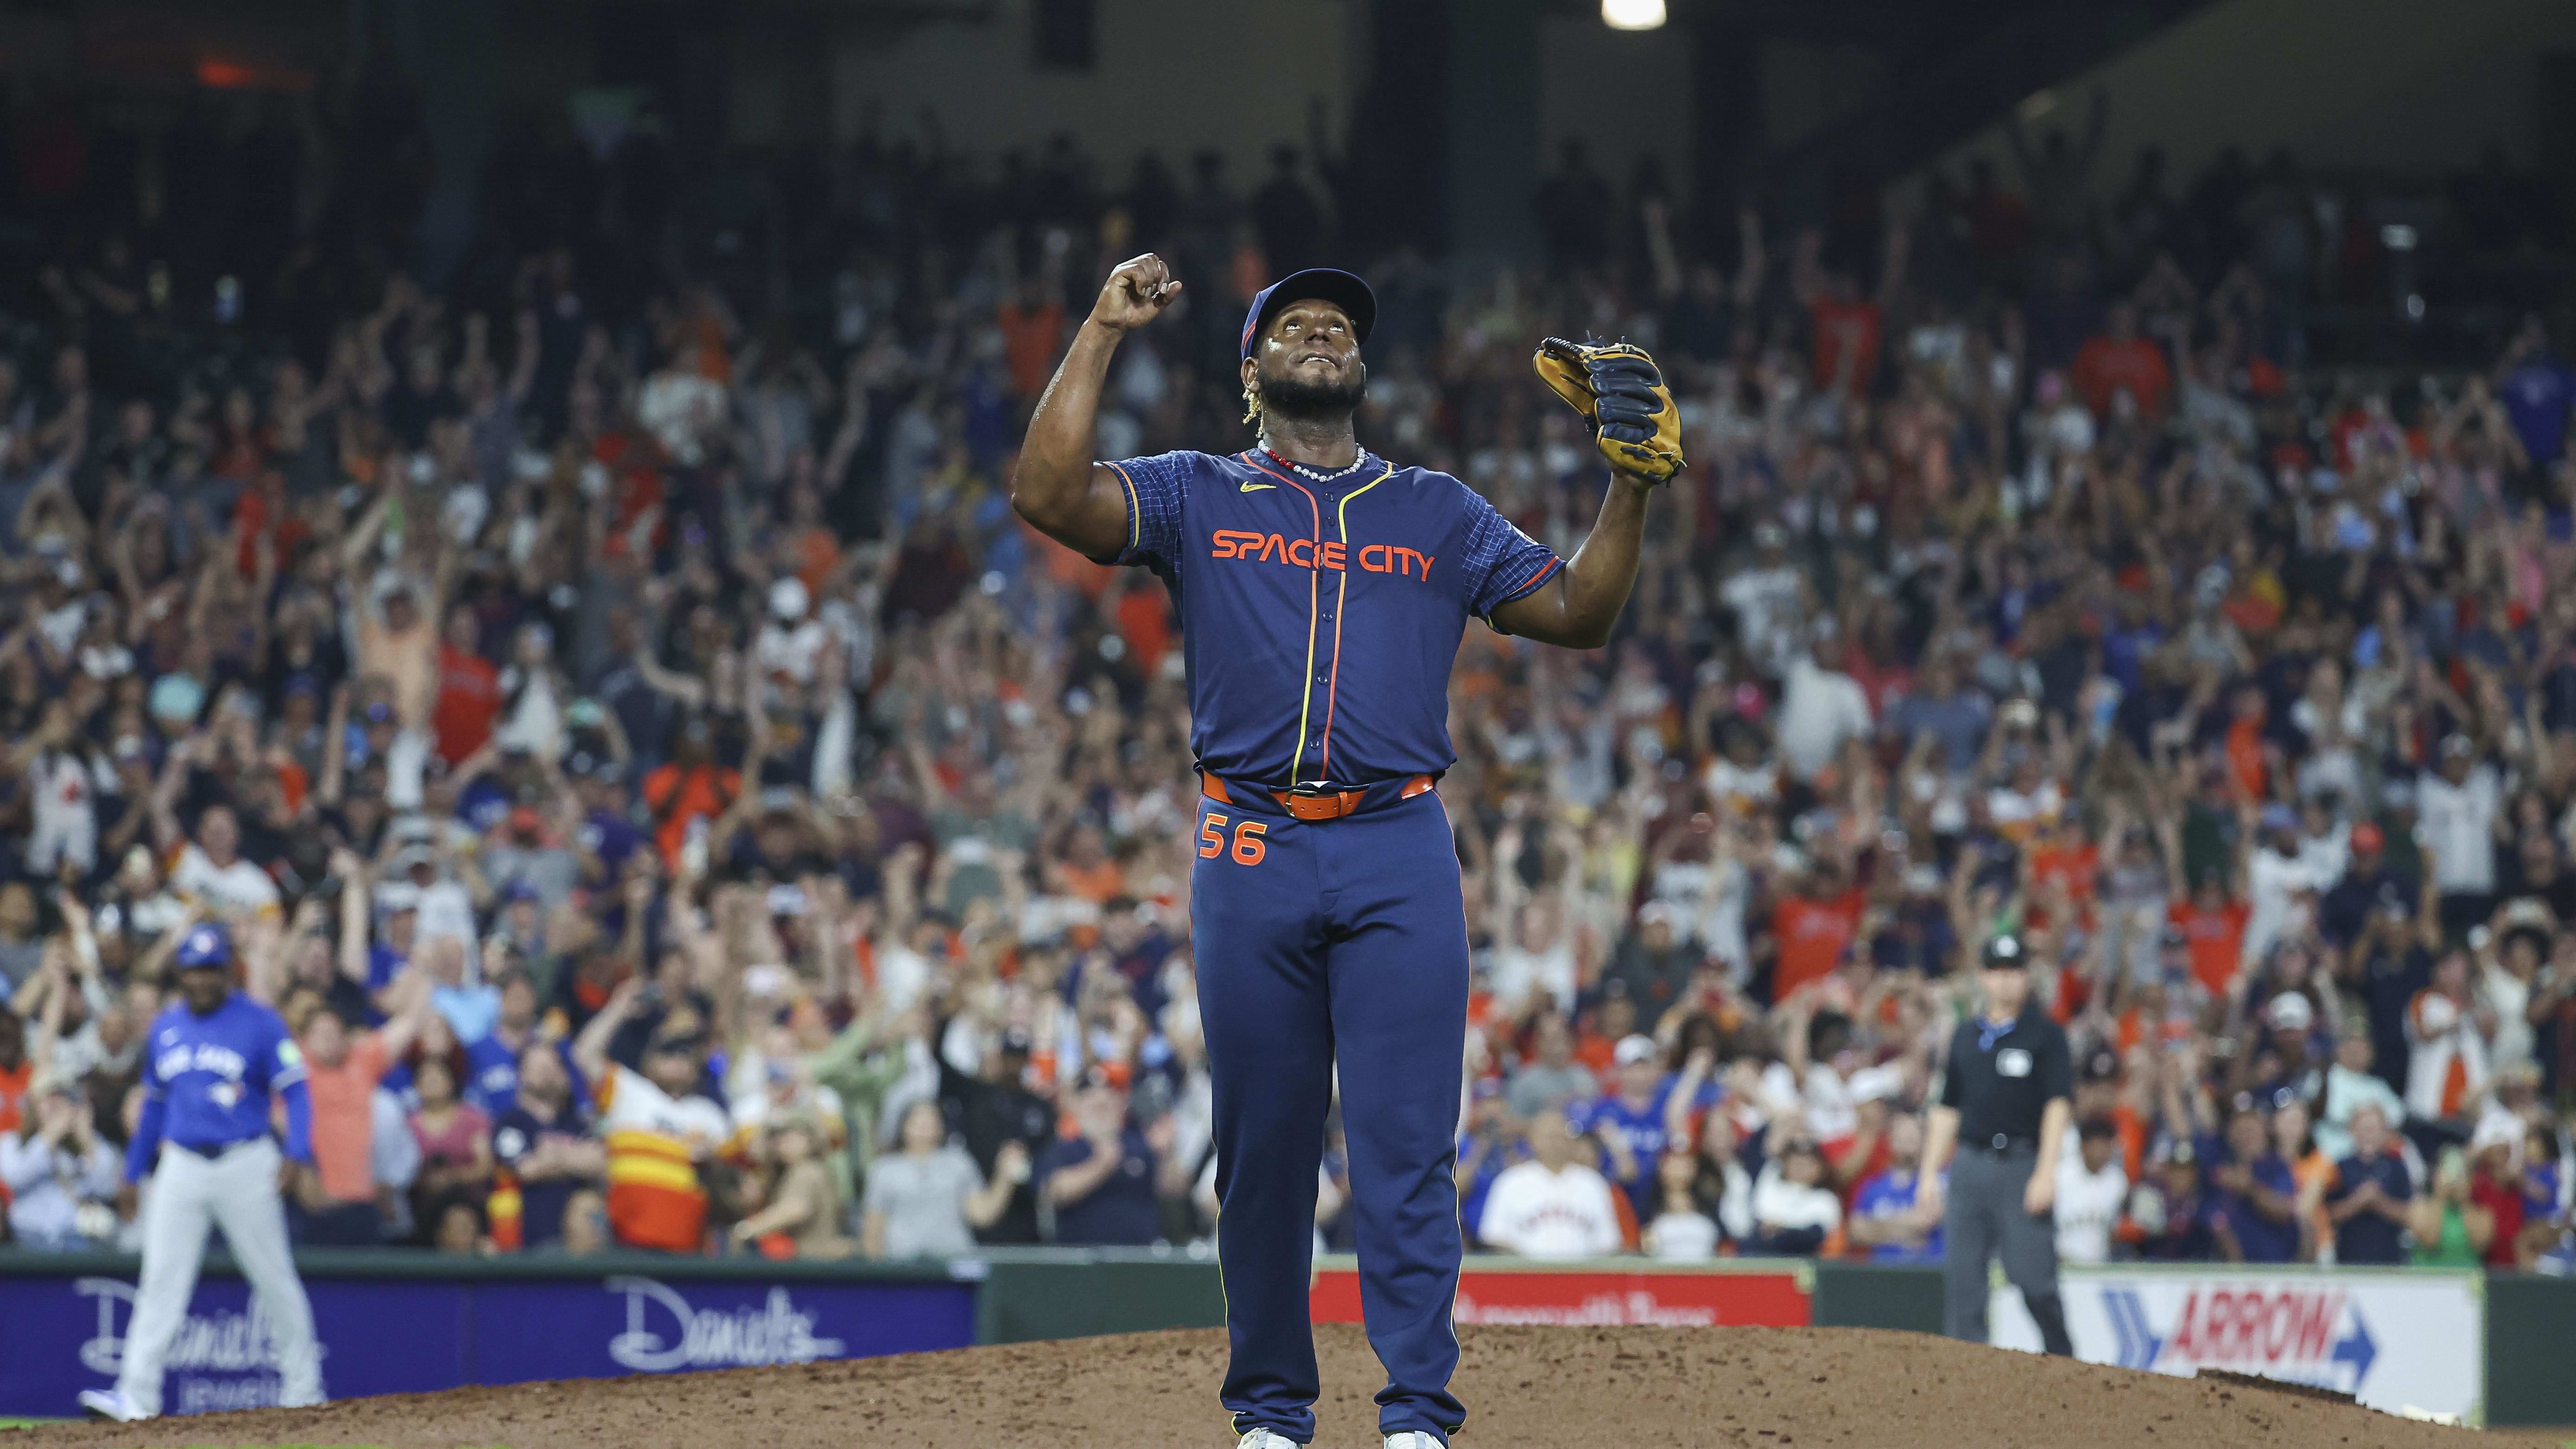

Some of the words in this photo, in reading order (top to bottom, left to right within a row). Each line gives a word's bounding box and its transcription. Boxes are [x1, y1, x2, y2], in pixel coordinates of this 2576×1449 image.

[1212, 529, 1346, 570] SPACE
[1359, 545, 1435, 581] CITY
[1199, 813, 1267, 866] 56
[2164, 1286, 2347, 1362] ARROW
